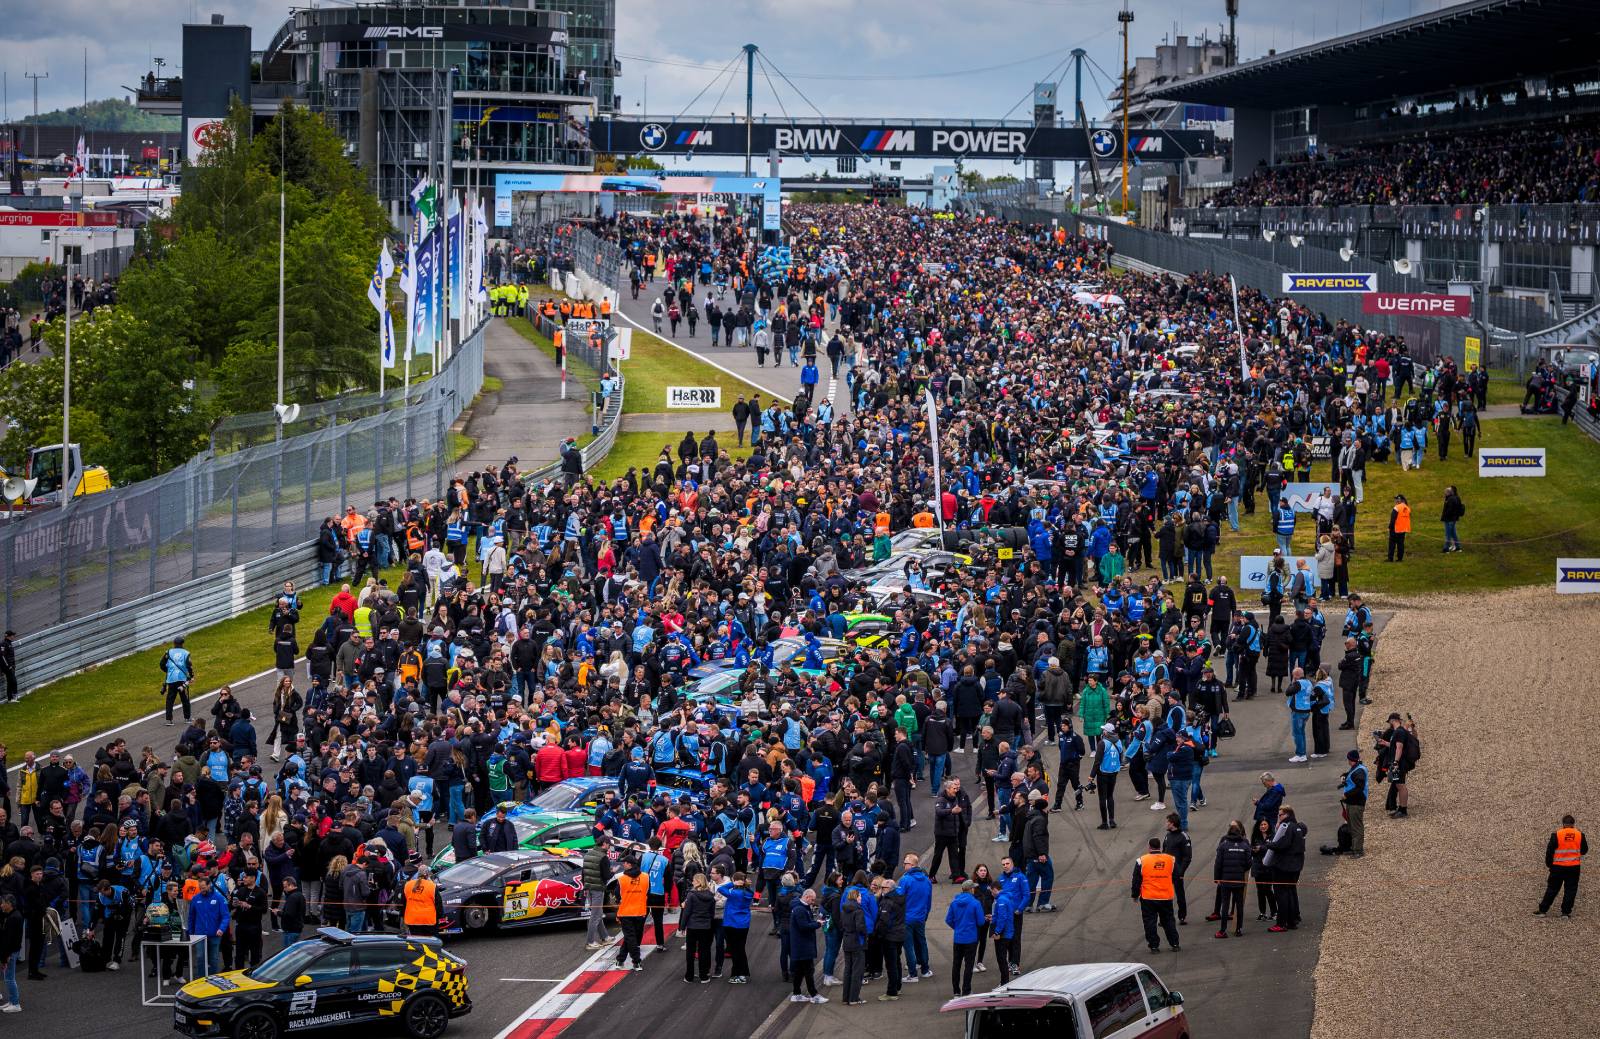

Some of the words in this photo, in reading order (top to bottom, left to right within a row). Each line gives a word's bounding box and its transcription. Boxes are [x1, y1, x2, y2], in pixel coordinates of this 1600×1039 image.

[383, 27, 443, 38] AMG
[689, 131, 712, 145] M
[775, 128, 841, 150] BMW
[881, 130, 915, 151] M
[932, 131, 1026, 153] POWER
[1140, 137, 1162, 152] M
[701, 193, 720, 203] H&R
[1296, 278, 1363, 288] RAVENOL
[1377, 297, 1456, 312] WEMPE
[673, 389, 699, 401] H&R
[15, 512, 94, 563] nürburring
[1567, 571, 1600, 580] RAVE
[357, 991, 402, 1001] LöhrGruppe
[289, 1018, 305, 1029] RACE
[305, 1011, 347, 1026] MANAGEMENT
